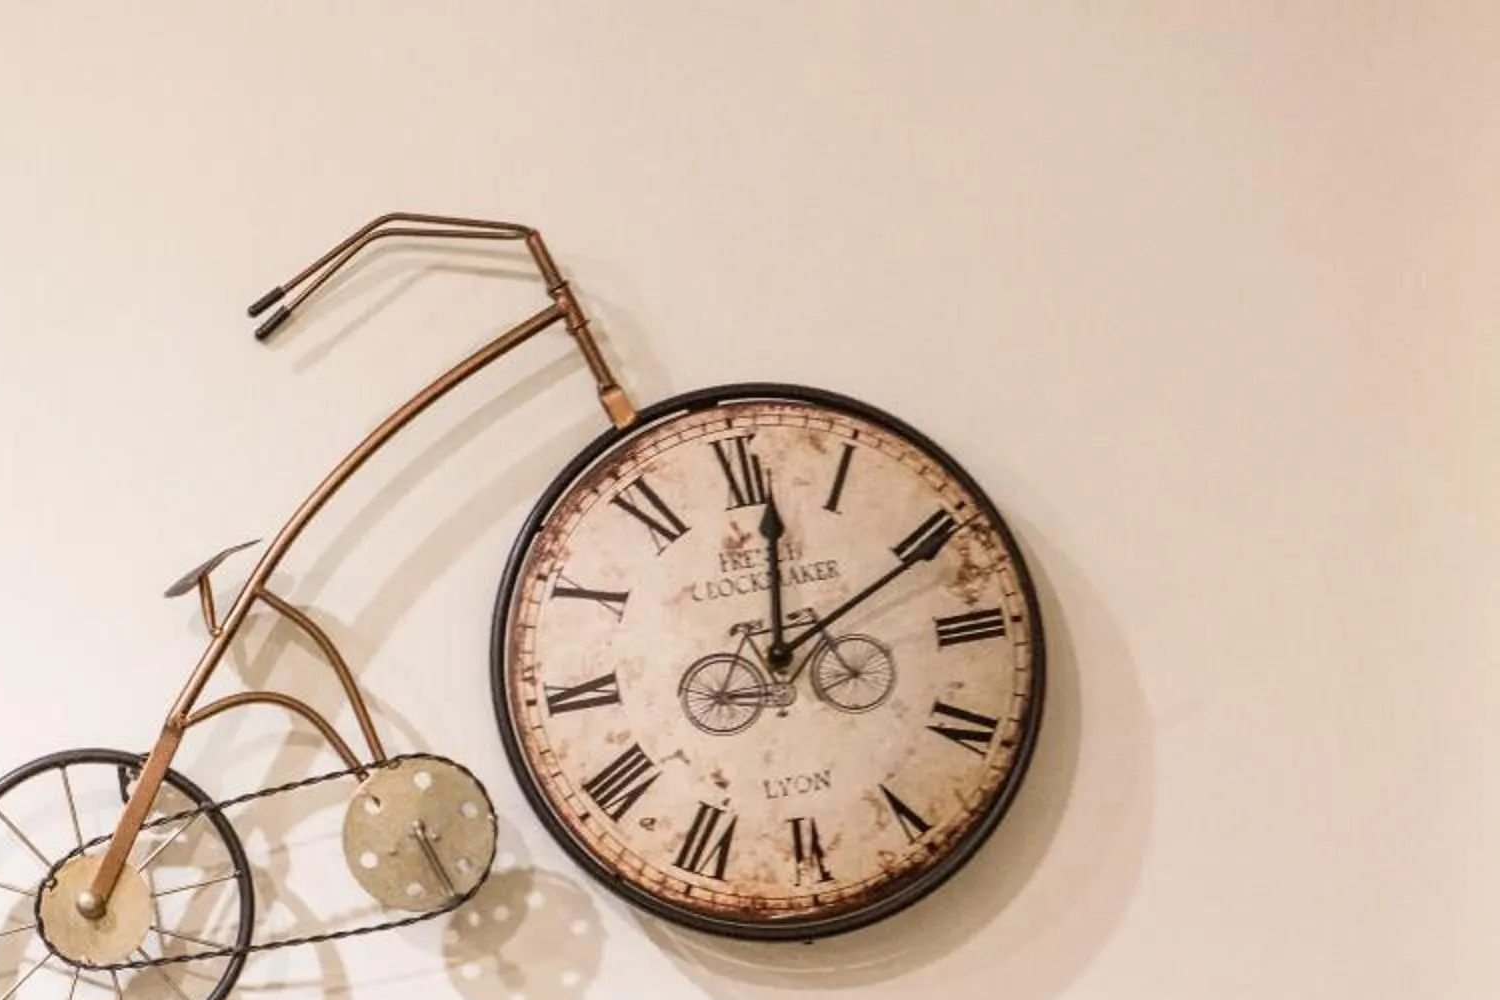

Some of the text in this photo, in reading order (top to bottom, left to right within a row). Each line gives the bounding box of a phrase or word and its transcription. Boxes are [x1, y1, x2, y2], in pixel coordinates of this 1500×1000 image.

[610, 475, 691, 556] XI
[551, 567, 629, 623] X
[932, 607, 1006, 651] III
[543, 671, 623, 716] IX
[581, 742, 662, 824] VIII
[763, 769, 831, 798] LYON
[671, 800, 738, 881] VII
